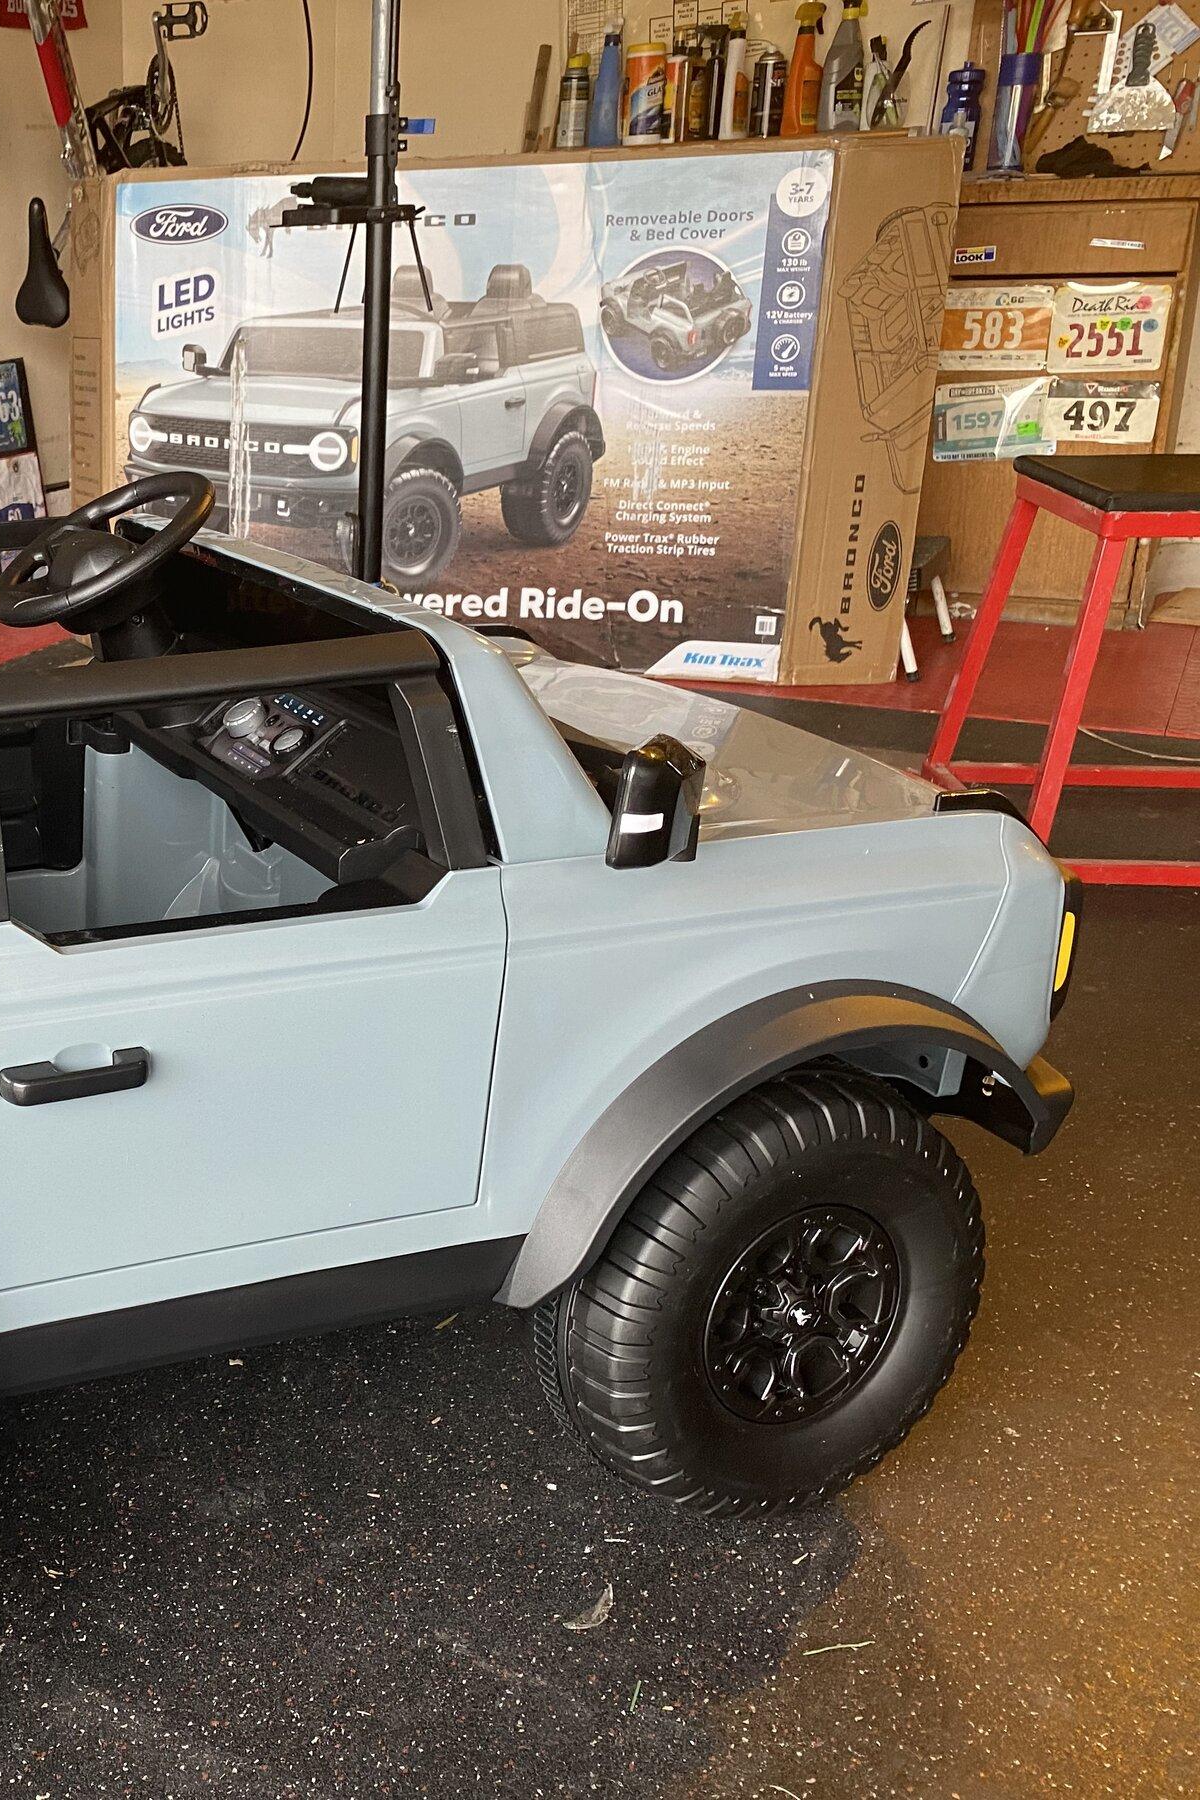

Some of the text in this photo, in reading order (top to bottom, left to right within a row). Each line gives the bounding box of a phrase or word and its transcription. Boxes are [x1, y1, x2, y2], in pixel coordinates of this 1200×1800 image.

[789, 181, 815, 196] 3-7
[788, 195, 814, 204] YEARS
[149, 210, 208, 238] Ford
[605, 208, 754, 228] Removeable Doors
[629, 226, 726, 242] & Bed Cover
[781, 258, 808, 267] 130 lb
[955, 253, 984, 263] LOOK
[157, 273, 216, 312] LED
[1071, 296, 1112, 313] Death
[156, 305, 216, 334] LIGHTS
[961, 310, 1025, 350] 583
[1065, 319, 1144, 359] 2551
[952, 410, 1003, 431] 1597
[1062, 399, 1138, 433] 497
[670, 443, 710, 456] Engine
[670, 454, 705, 466] Effect
[603, 478, 620, 488] FM
[669, 478, 696, 490] MP3
[698, 479, 731, 492] Input
[618, 500, 653, 511] Direct
[615, 511, 712, 525] Charging System
[604, 531, 641, 543] Power
[676, 533, 720, 545] Rubber
[839, 474, 866, 614] BRONCO
[606, 543, 716, 558] Traction Strip Tires
[870, 538, 898, 595] Ford
[519, 586, 684, 623] Ride-On
